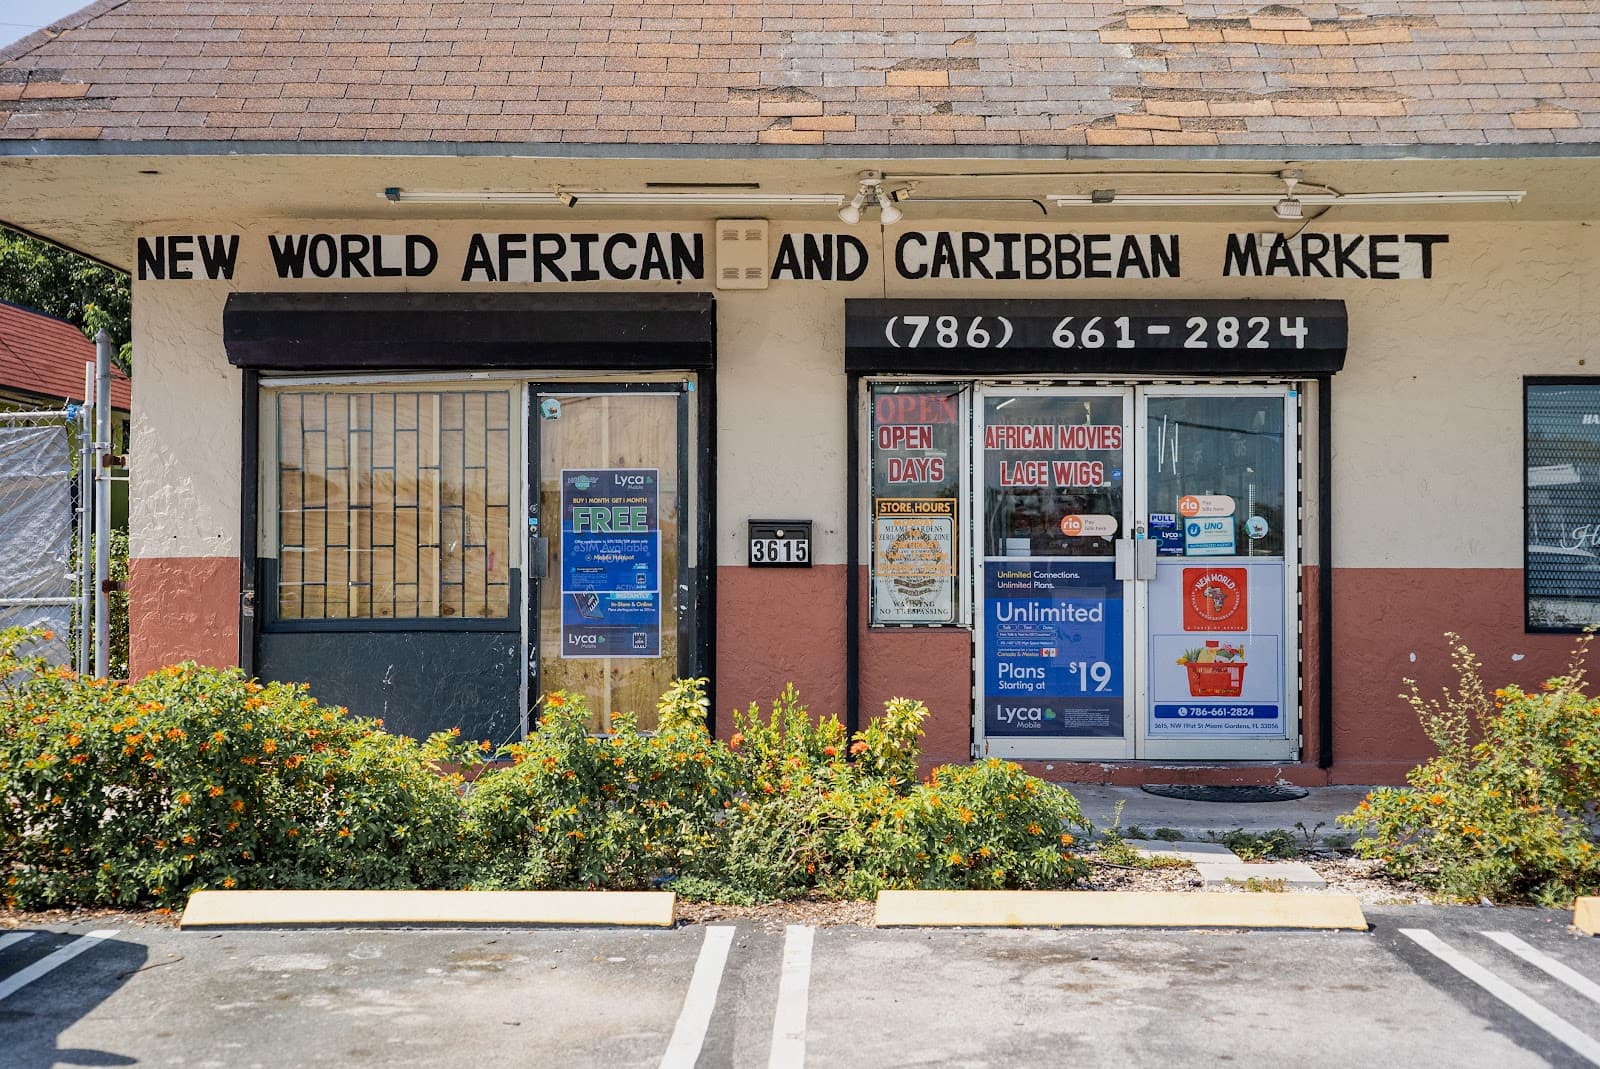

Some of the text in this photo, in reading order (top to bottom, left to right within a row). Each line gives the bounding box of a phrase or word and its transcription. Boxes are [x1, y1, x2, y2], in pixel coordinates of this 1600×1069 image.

[138, 231, 1450, 282] NEW WORLD AFRICAN AND CARIBBEAN MARKET
[884, 315, 1309, 350] (786) 661-2824
[876, 393, 957, 424] OPEN
[879, 425, 933, 450] OPEN
[984, 425, 1122, 450] AFRICAN MOVIES
[888, 457, 944, 483] DAYS
[1000, 461, 1104, 487] LACE WIGS
[615, 474, 644, 487] Lyca
[881, 502, 951, 513] STORE HOURS
[1181, 498, 1199, 509] ria
[572, 506, 649, 534] FREE
[1063, 517, 1081, 529] ria
[753, 540, 807, 562] 3615
[997, 571, 1080, 579] Unlimited Connections.
[997, 581, 1055, 589] Unlimited Plans.
[1195, 573, 1236, 590] NEW WORLD
[996, 601, 1103, 622] Unlimited
[568, 633, 597, 646] Lyca
[998, 662, 1046, 679] Plans
[1069, 661, 1112, 692] $19
[998, 680, 1046, 692] Starting at
[997, 704, 1042, 724] Lyca
[1190, 707, 1254, 717] 786-661-2824
